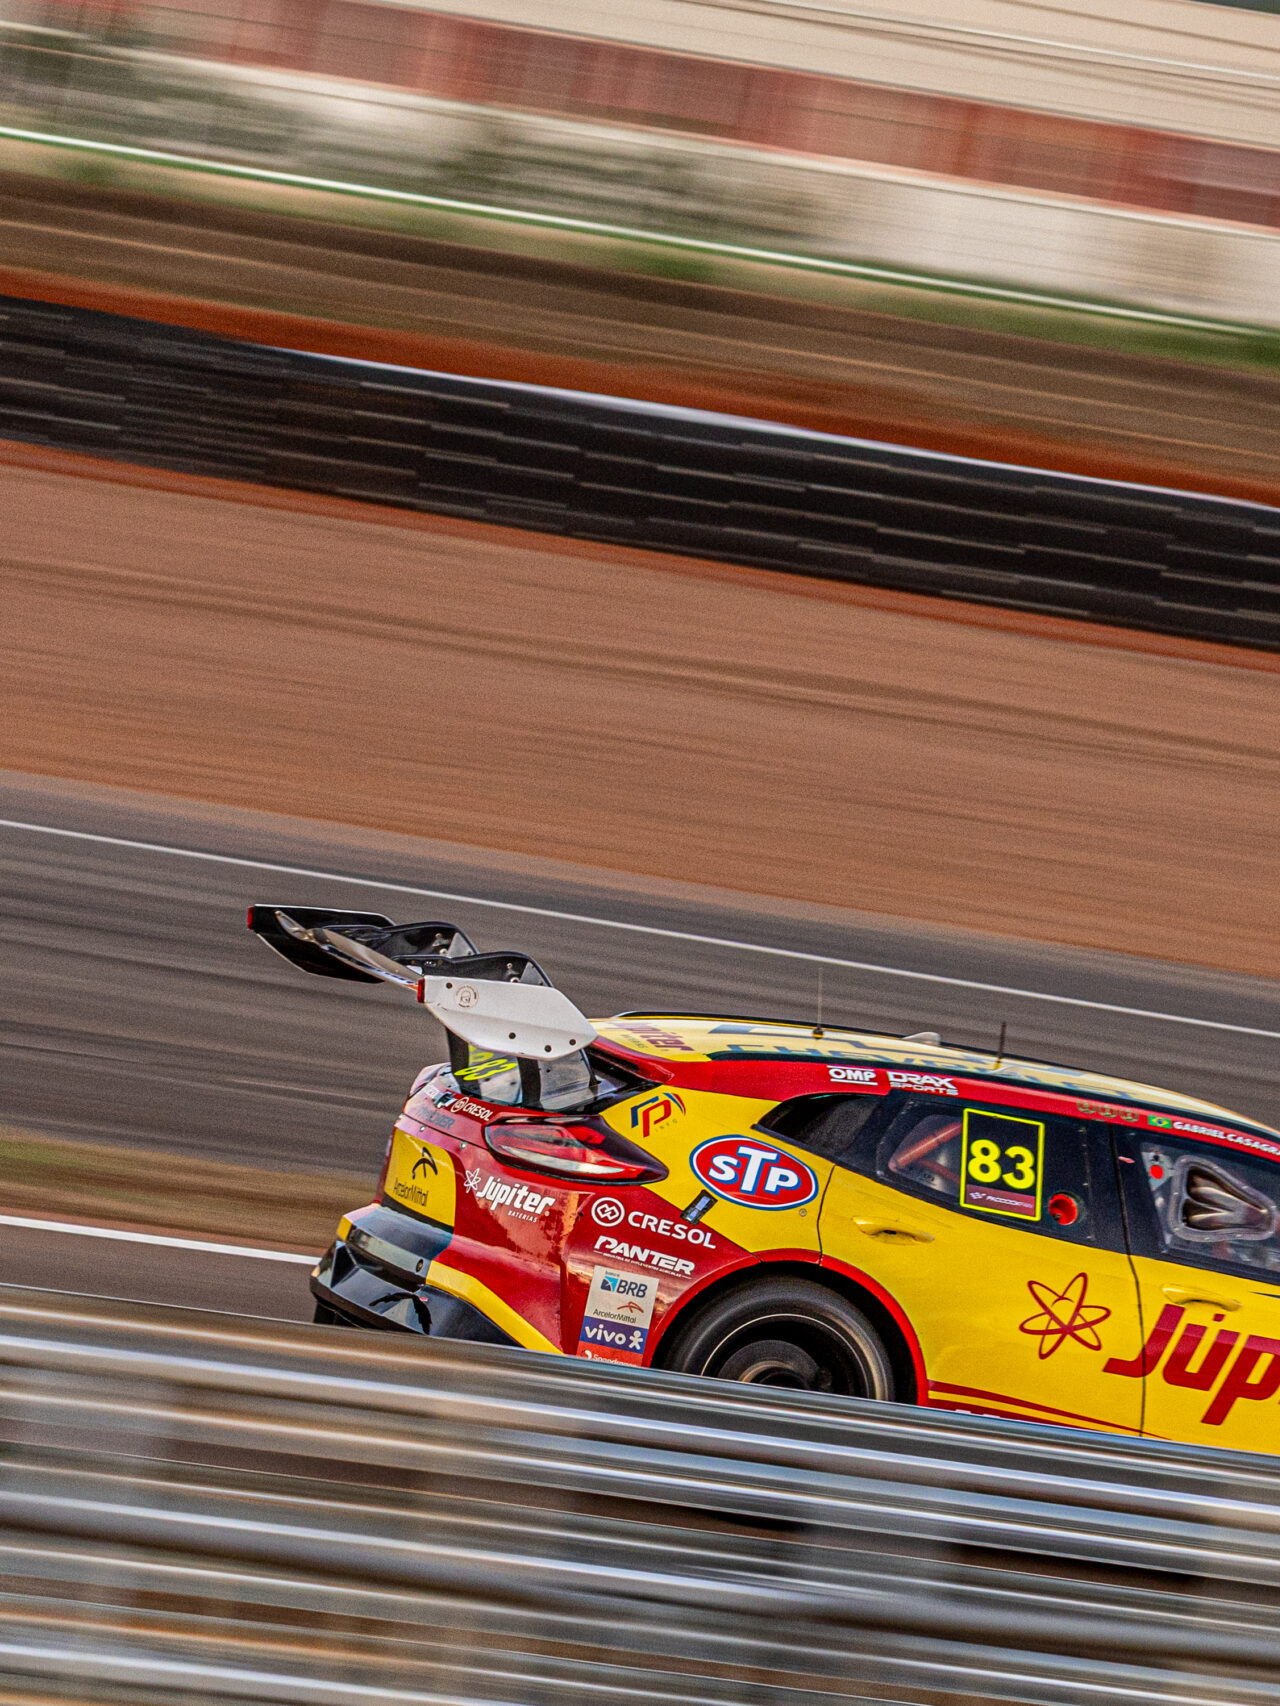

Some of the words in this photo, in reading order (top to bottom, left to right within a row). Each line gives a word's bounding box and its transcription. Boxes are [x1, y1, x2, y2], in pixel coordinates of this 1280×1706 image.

[828, 1068, 877, 1082] OMP
[886, 1071, 957, 1090] DRAX
[889, 1081, 959, 1096] SPORTS
[462, 1102, 494, 1121] CRESOL
[707, 1145, 802, 1195] STP
[967, 1138, 1036, 1190] 83
[475, 1175, 556, 1216] Júpiter
[507, 1209, 539, 1223] BATERIAS
[627, 1210, 717, 1250] CRESOL
[593, 1234, 696, 1276] PANTER
[616, 1279, 648, 1298] BRB
[592, 1308, 637, 1324] ArcelorMittal
[584, 1323, 627, 1345] vivo
